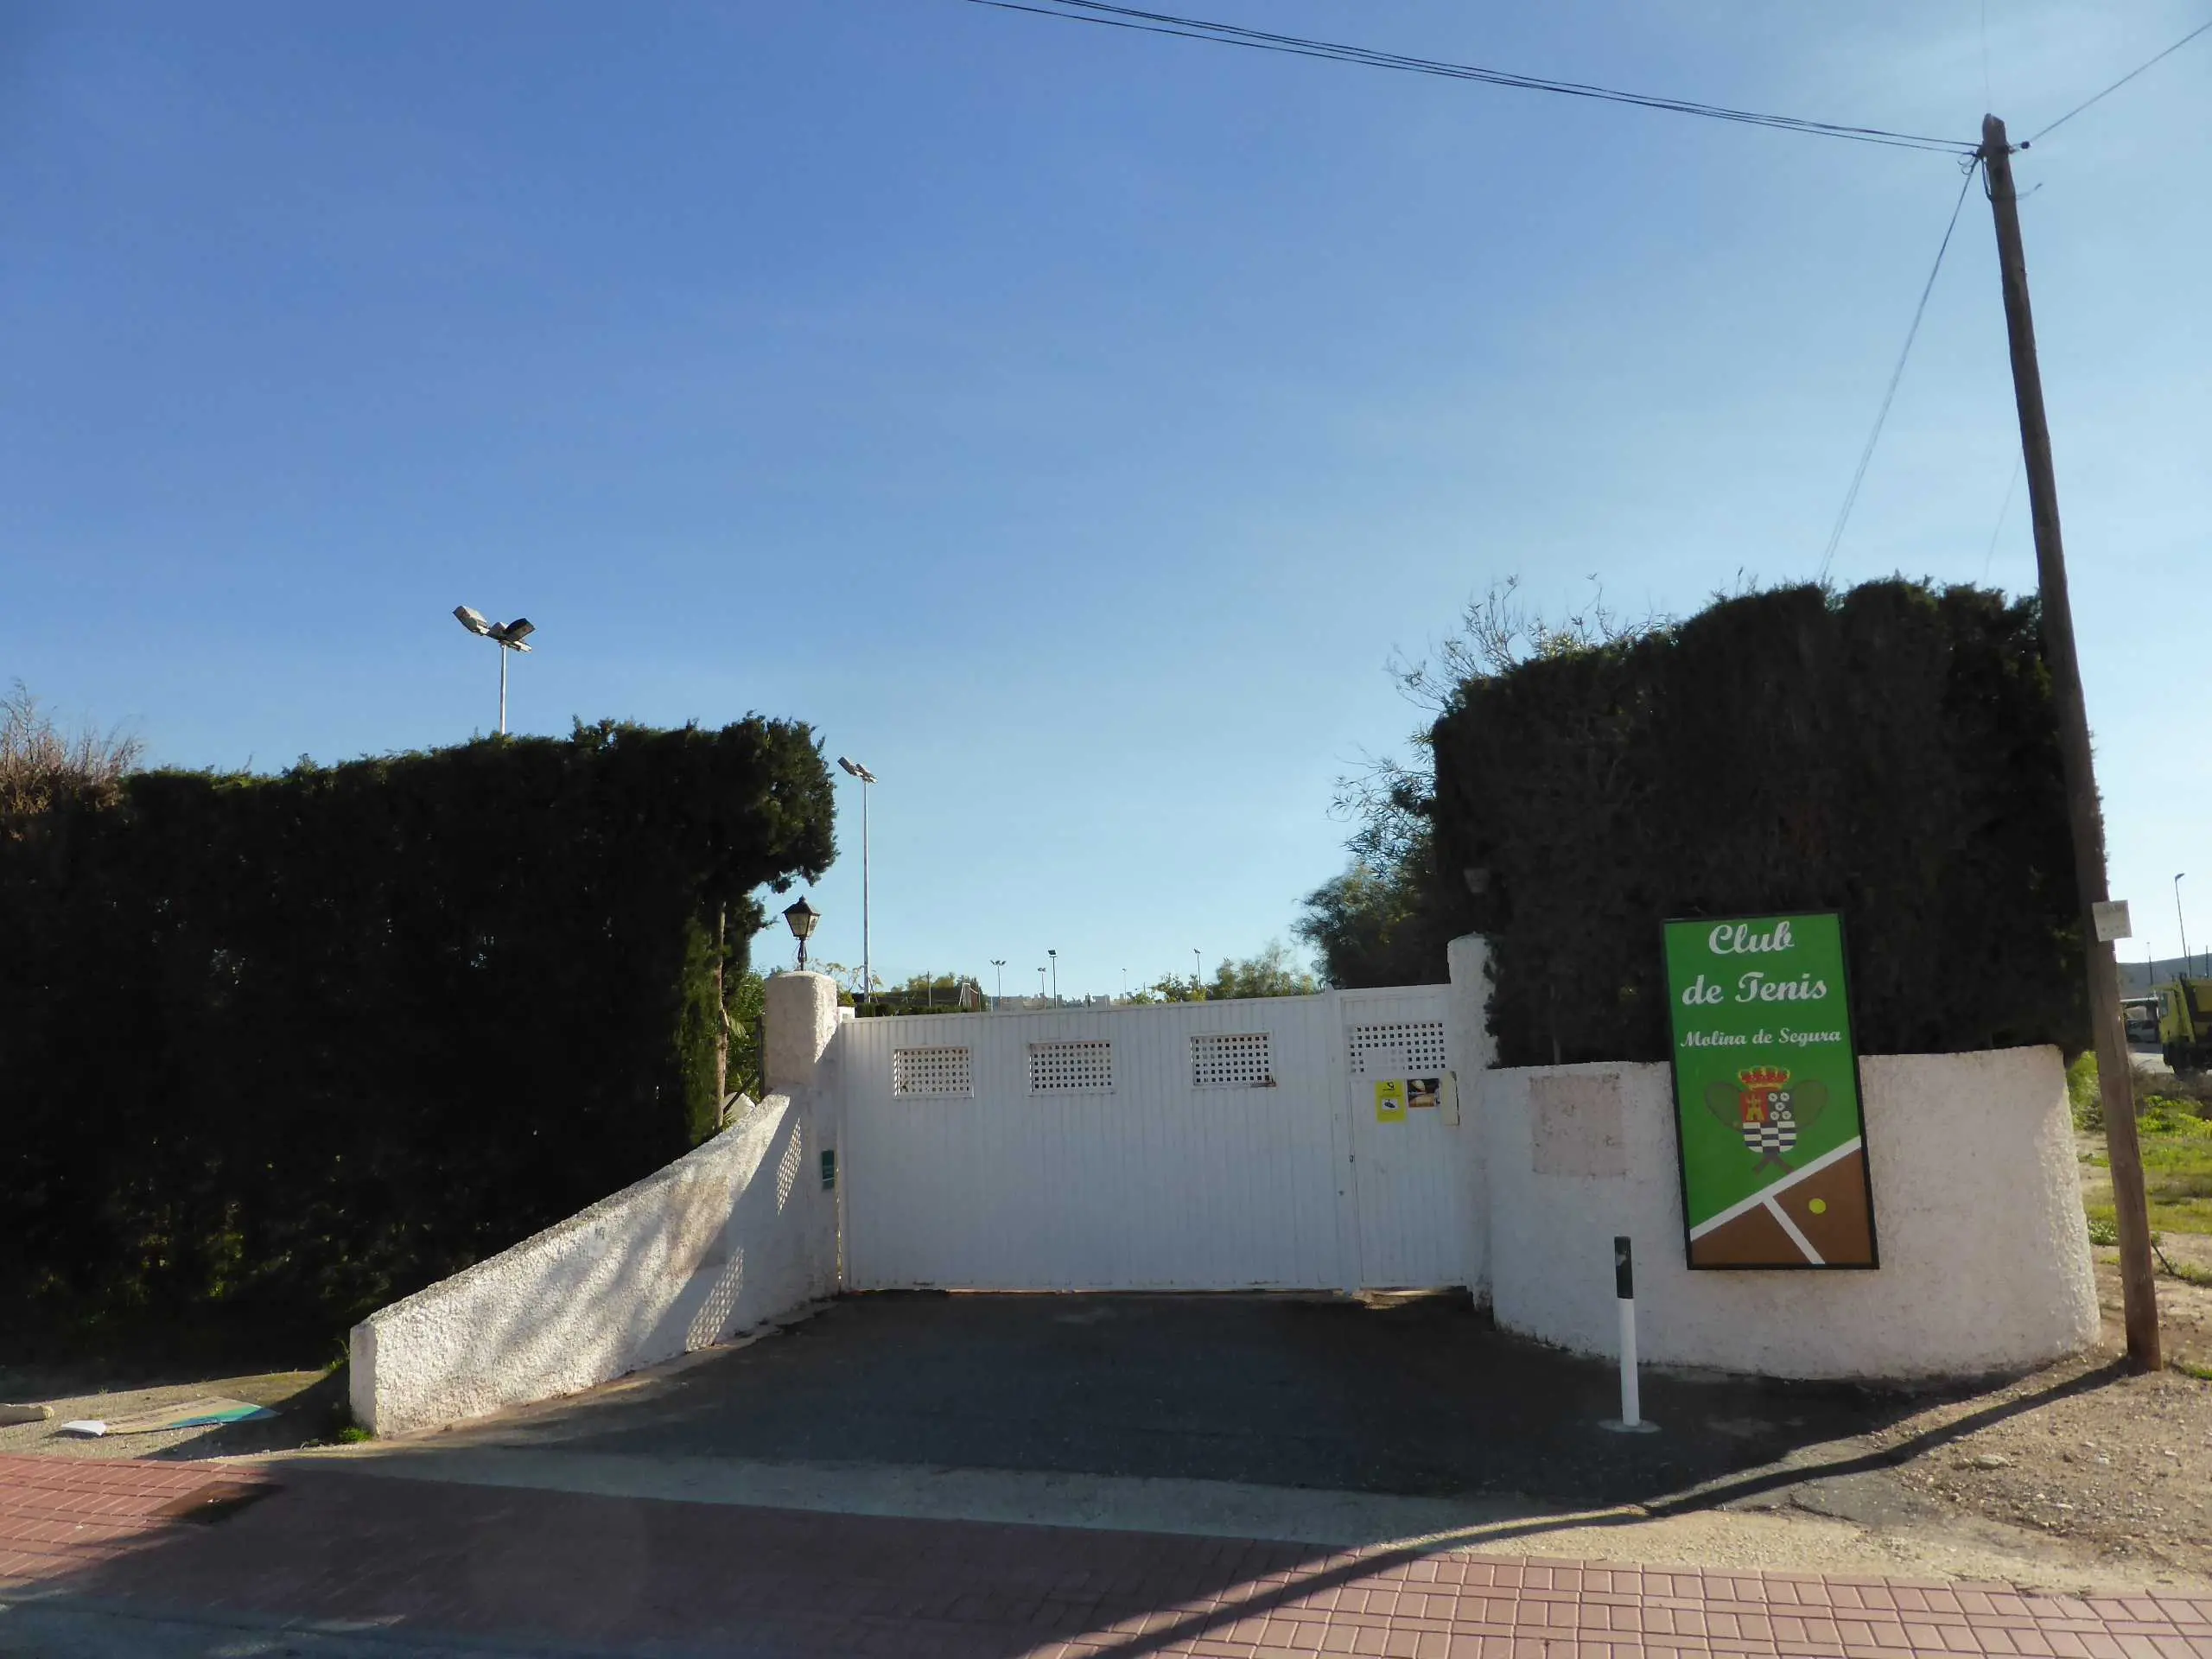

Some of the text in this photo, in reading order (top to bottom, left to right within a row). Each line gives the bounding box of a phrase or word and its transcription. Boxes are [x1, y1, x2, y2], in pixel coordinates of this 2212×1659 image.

[1708, 921, 1794, 954] Club
[1681, 971, 1827, 1005] de Tenis
[1680, 1028, 1842, 1047] Molina de Segura
